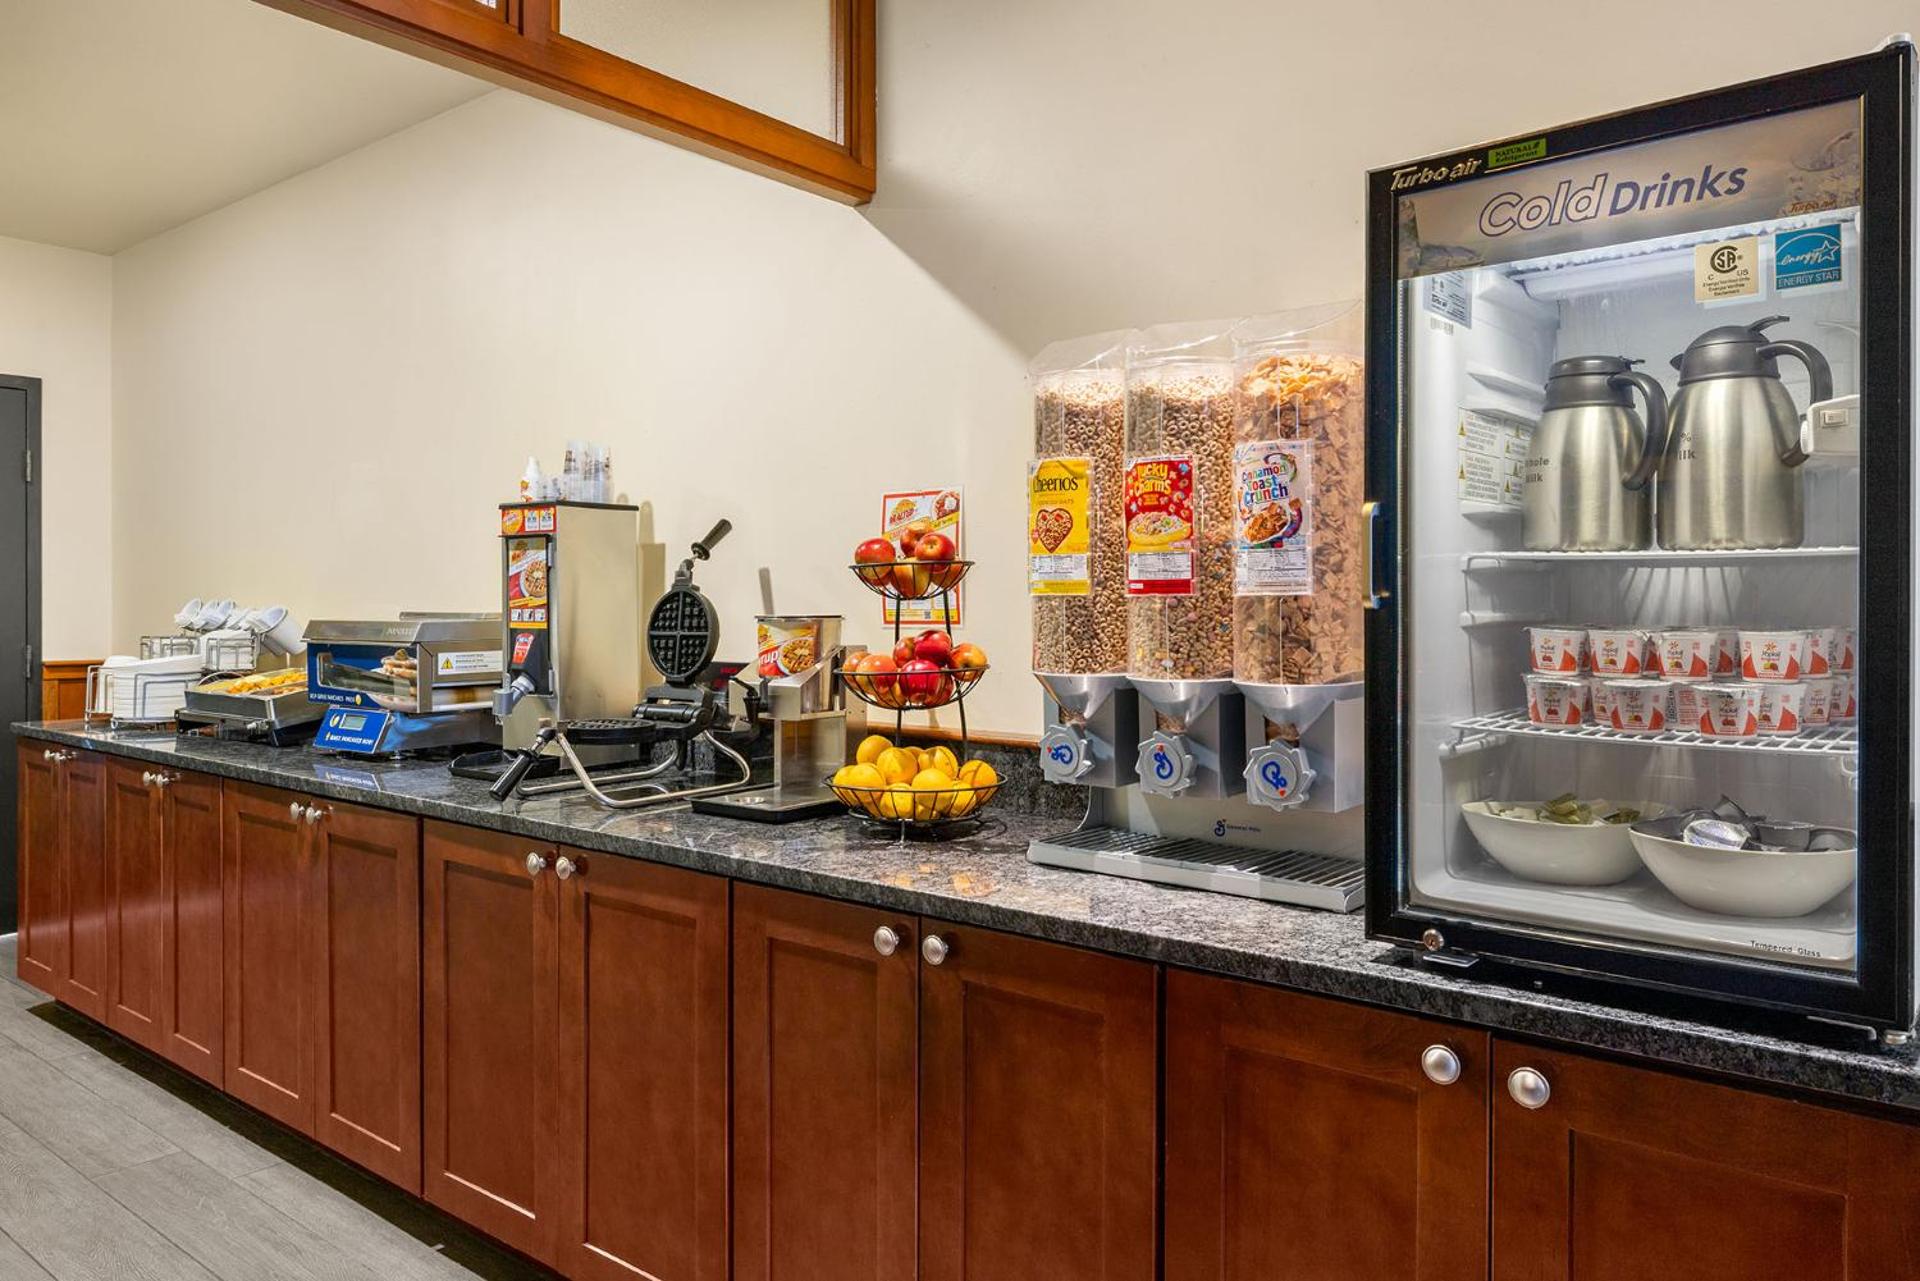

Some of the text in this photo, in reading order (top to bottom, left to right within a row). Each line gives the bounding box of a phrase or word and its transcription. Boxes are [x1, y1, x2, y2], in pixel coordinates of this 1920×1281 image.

[1390, 158, 1482, 190] Turbo air
[1479, 164, 1748, 238] Cold Drinks
[1778, 271, 1840, 288] ENERGY STAR
[1751, 940, 1822, 957] Tempered Glass
